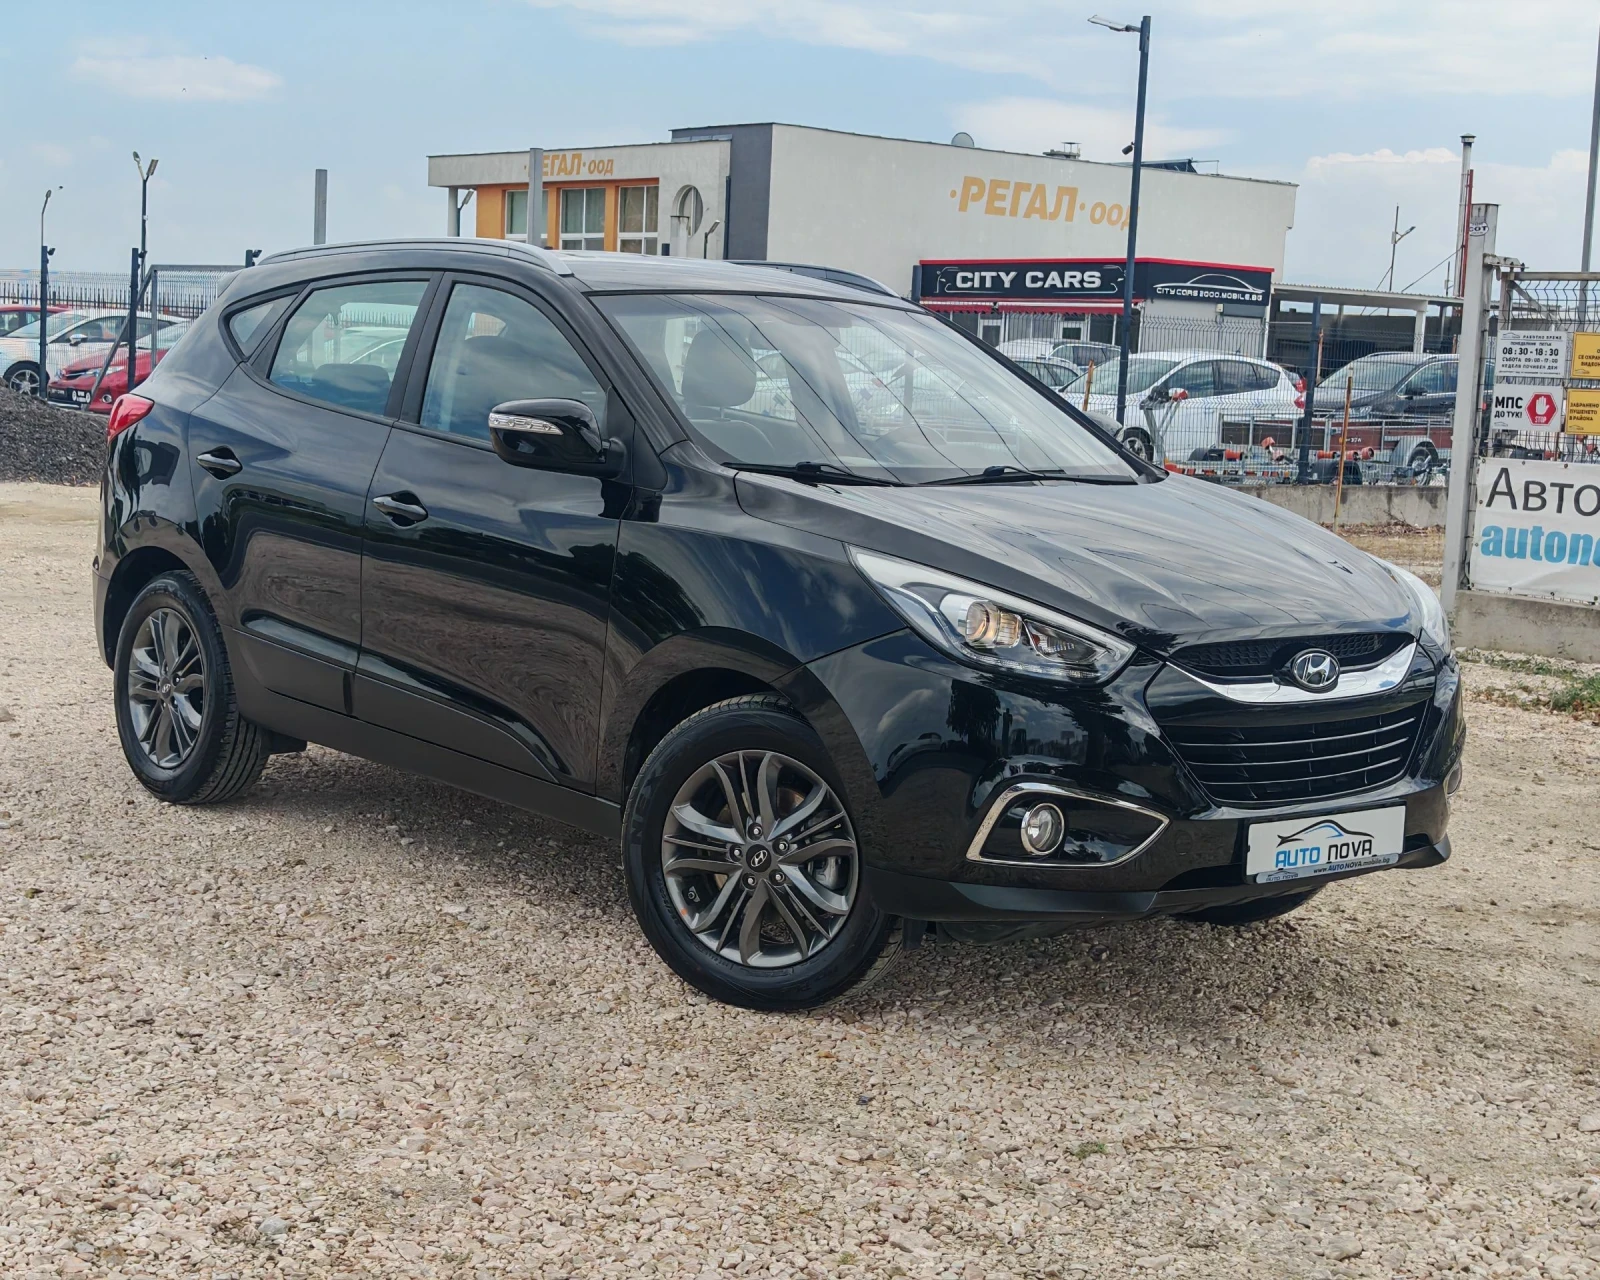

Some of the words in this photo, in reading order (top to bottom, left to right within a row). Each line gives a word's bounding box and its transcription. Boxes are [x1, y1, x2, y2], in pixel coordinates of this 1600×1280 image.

[528, 153, 582, 177] ЕГАЛ
[958, 176, 1078, 223] РЕГАЛ
[955, 271, 1017, 289] CITY
[1025, 271, 1102, 289] CARS
[1156, 287, 1175, 295] CITY
[1176, 289, 1198, 297] CARS
[1495, 396, 1523, 409] МПС
[1494, 410, 1505, 418] ДО
[1275, 847, 1321, 868] AUTO
[1327, 839, 1373, 862] NOVA
